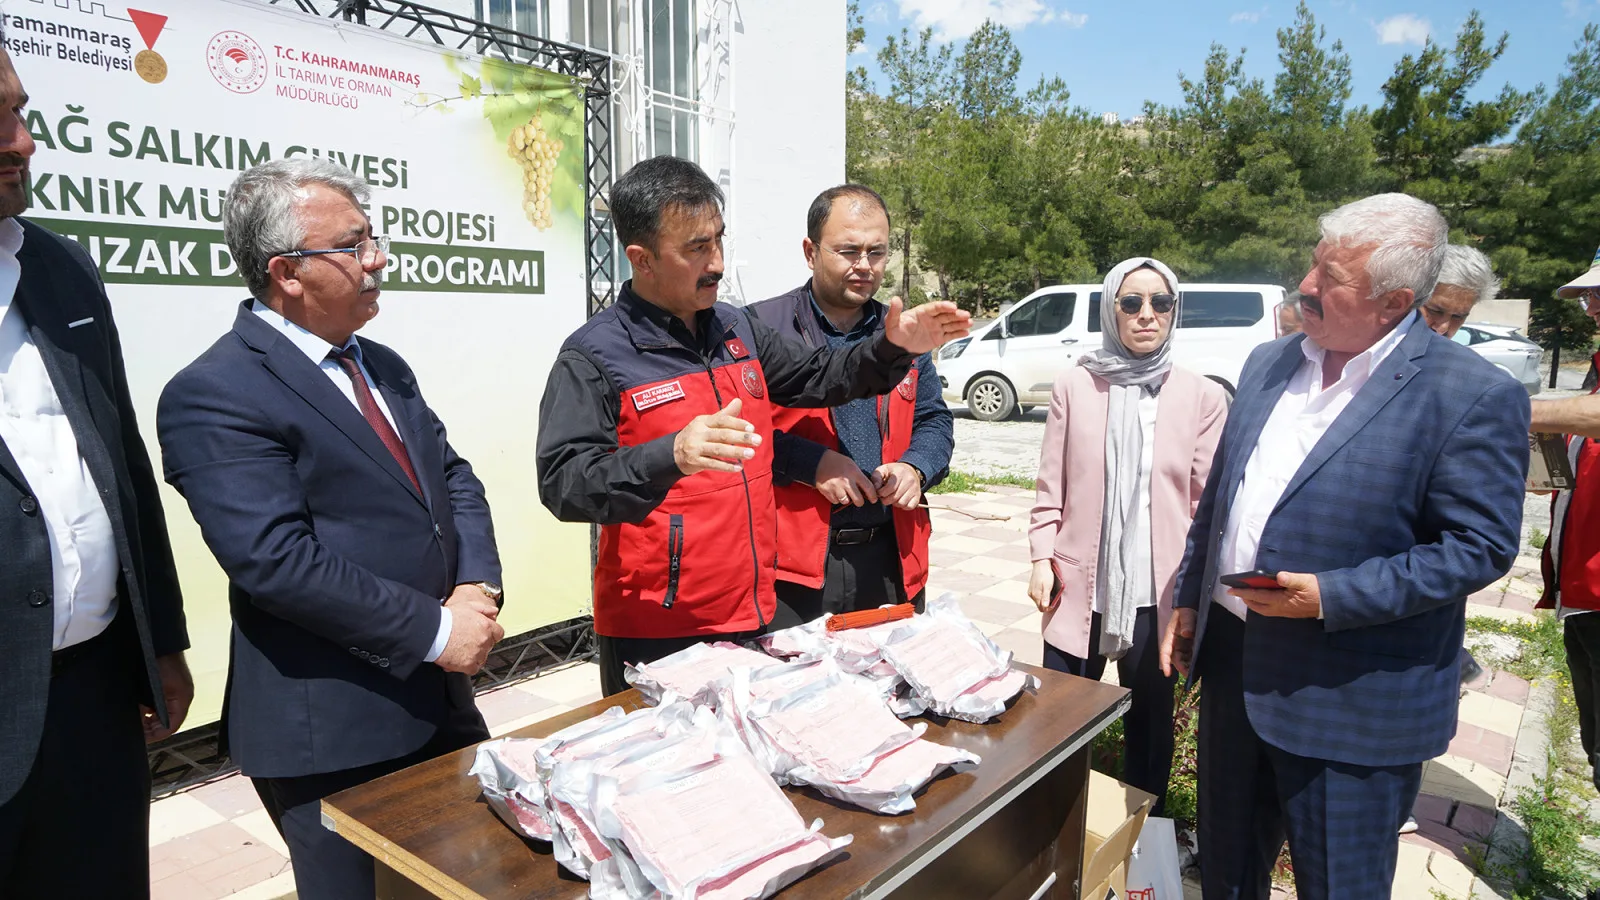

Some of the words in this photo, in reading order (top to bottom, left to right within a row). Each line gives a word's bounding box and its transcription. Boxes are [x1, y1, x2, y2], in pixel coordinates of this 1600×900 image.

[3, 13, 132, 53] ramanmaraş
[3, 36, 53, 57] kşehir
[57, 42, 133, 72] Belediyesi
[273, 45, 298, 61] T.C.
[301, 50, 421, 88] KAHRAMANMARAŞ
[275, 84, 358, 110] MÜDÜRLÜĞÜ
[288, 66, 328, 86] TARIM
[330, 75, 345, 89] VE
[347, 79, 392, 98] ORMAN
[26, 103, 93, 154] AĞ
[106, 120, 271, 171] SALKIM
[382, 253, 539, 287] PROGRAMI
